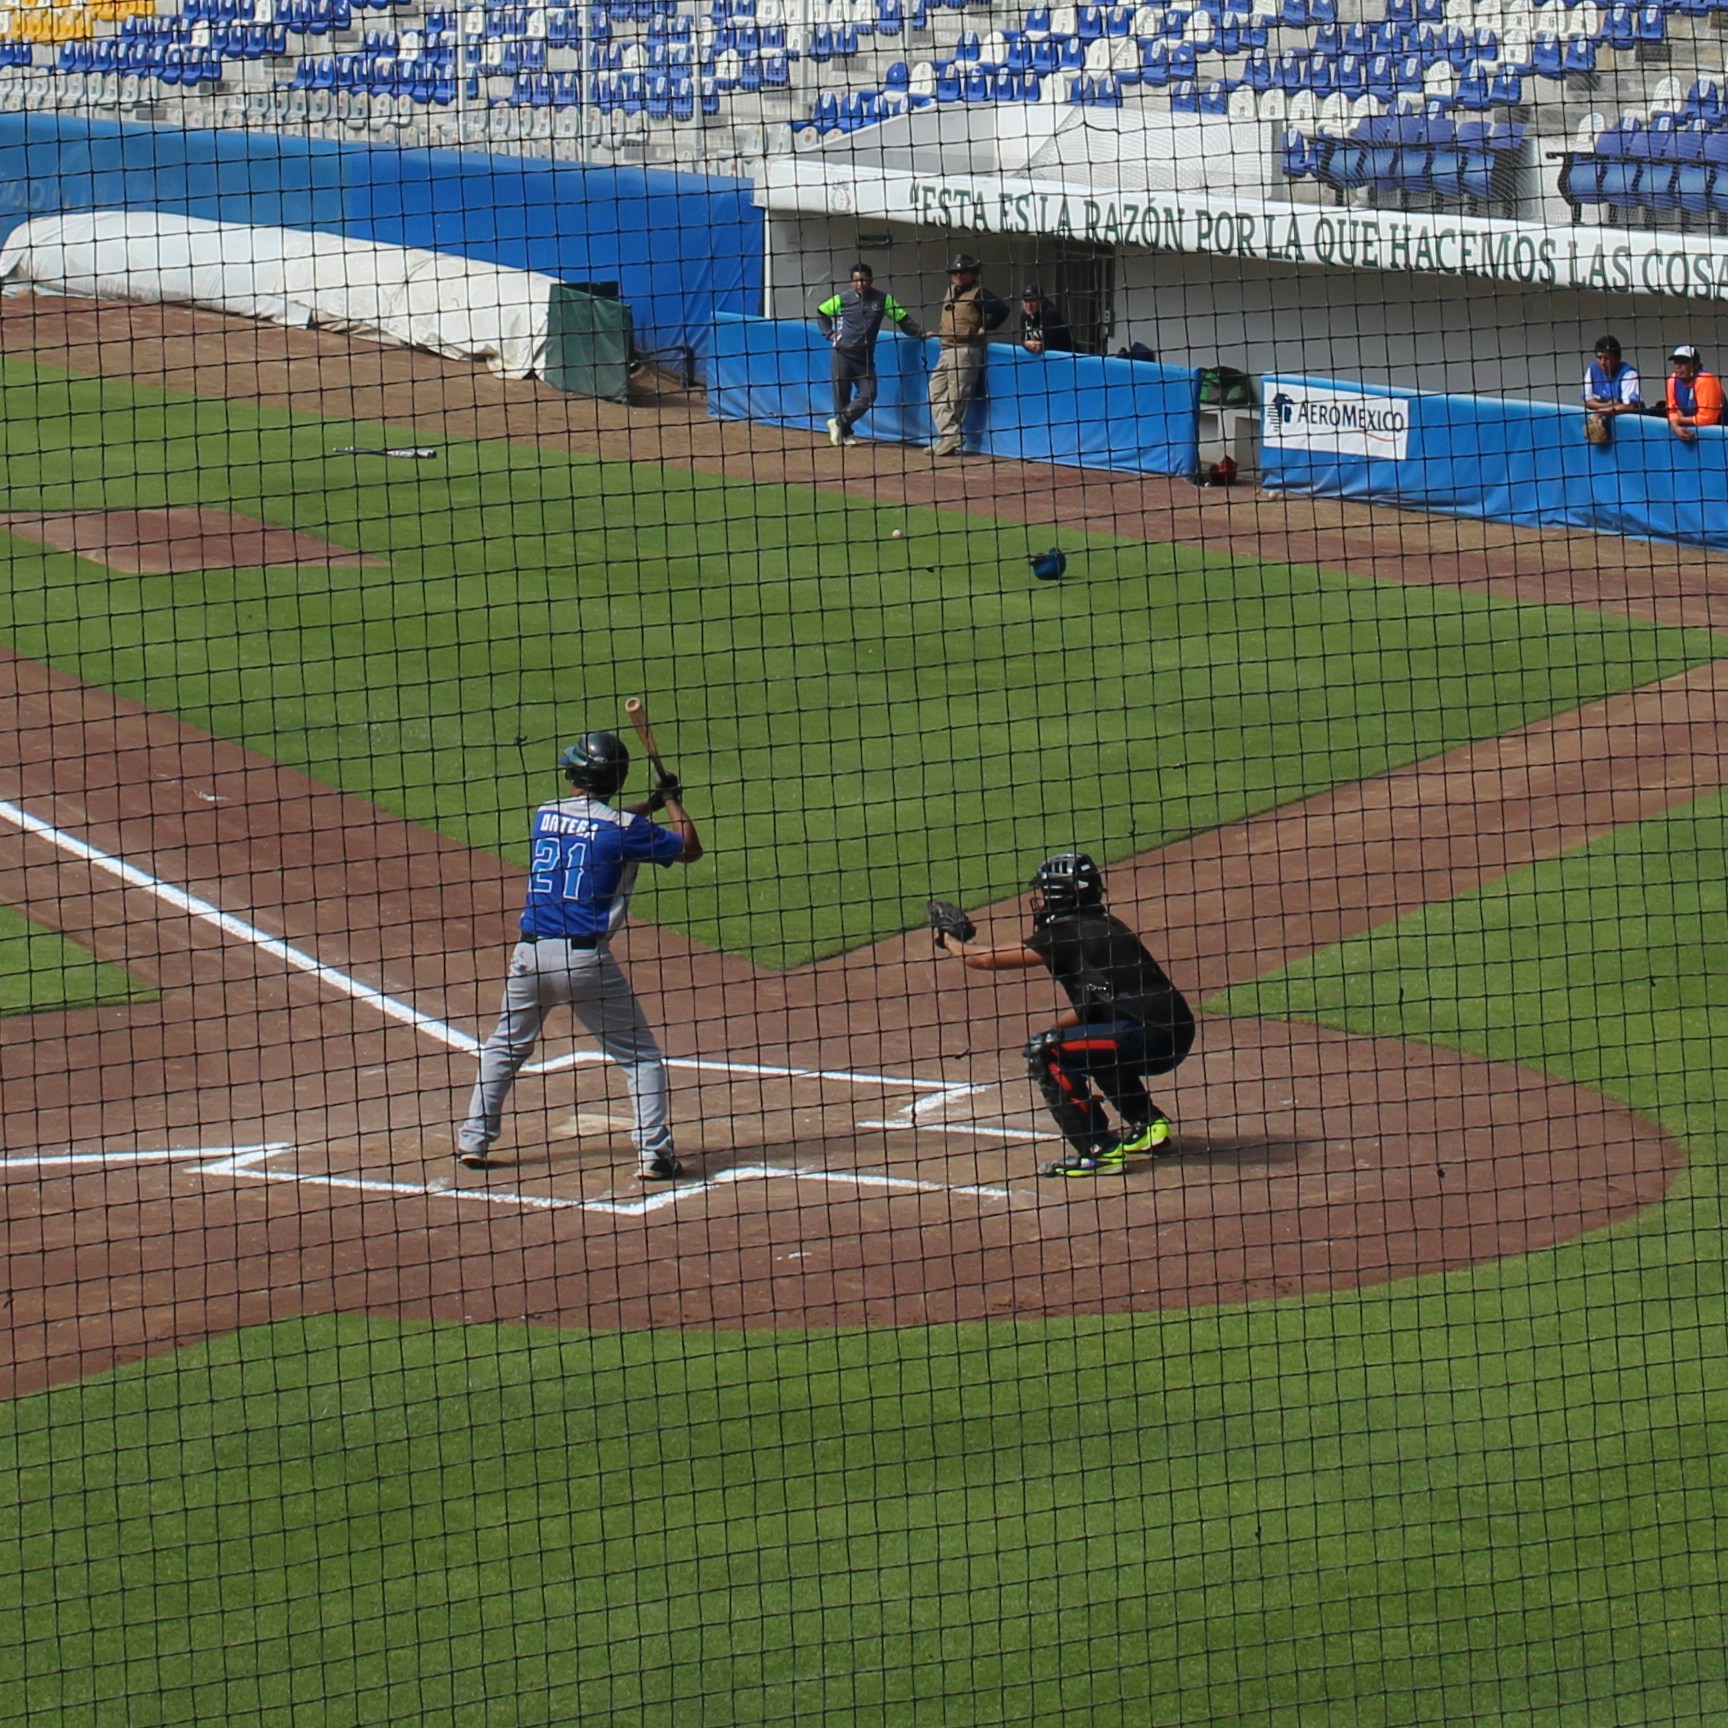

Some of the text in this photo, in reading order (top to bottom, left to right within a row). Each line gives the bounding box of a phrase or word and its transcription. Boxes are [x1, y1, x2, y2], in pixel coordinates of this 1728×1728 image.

[999, 191, 1031, 235] ES
[1039, 195, 1077, 239] LA
[1083, 196, 1187, 253] RAZÓN
[1194, 208, 1259, 258] POR
[1267, 214, 1306, 262] LA
[1313, 216, 1379, 269] QUE
[1389, 223, 1557, 286] HACEMOS
[1568, 238, 1633, 294] LAS
[540, 813, 599, 841] ORTEGA
[528, 837, 587, 901] 21
